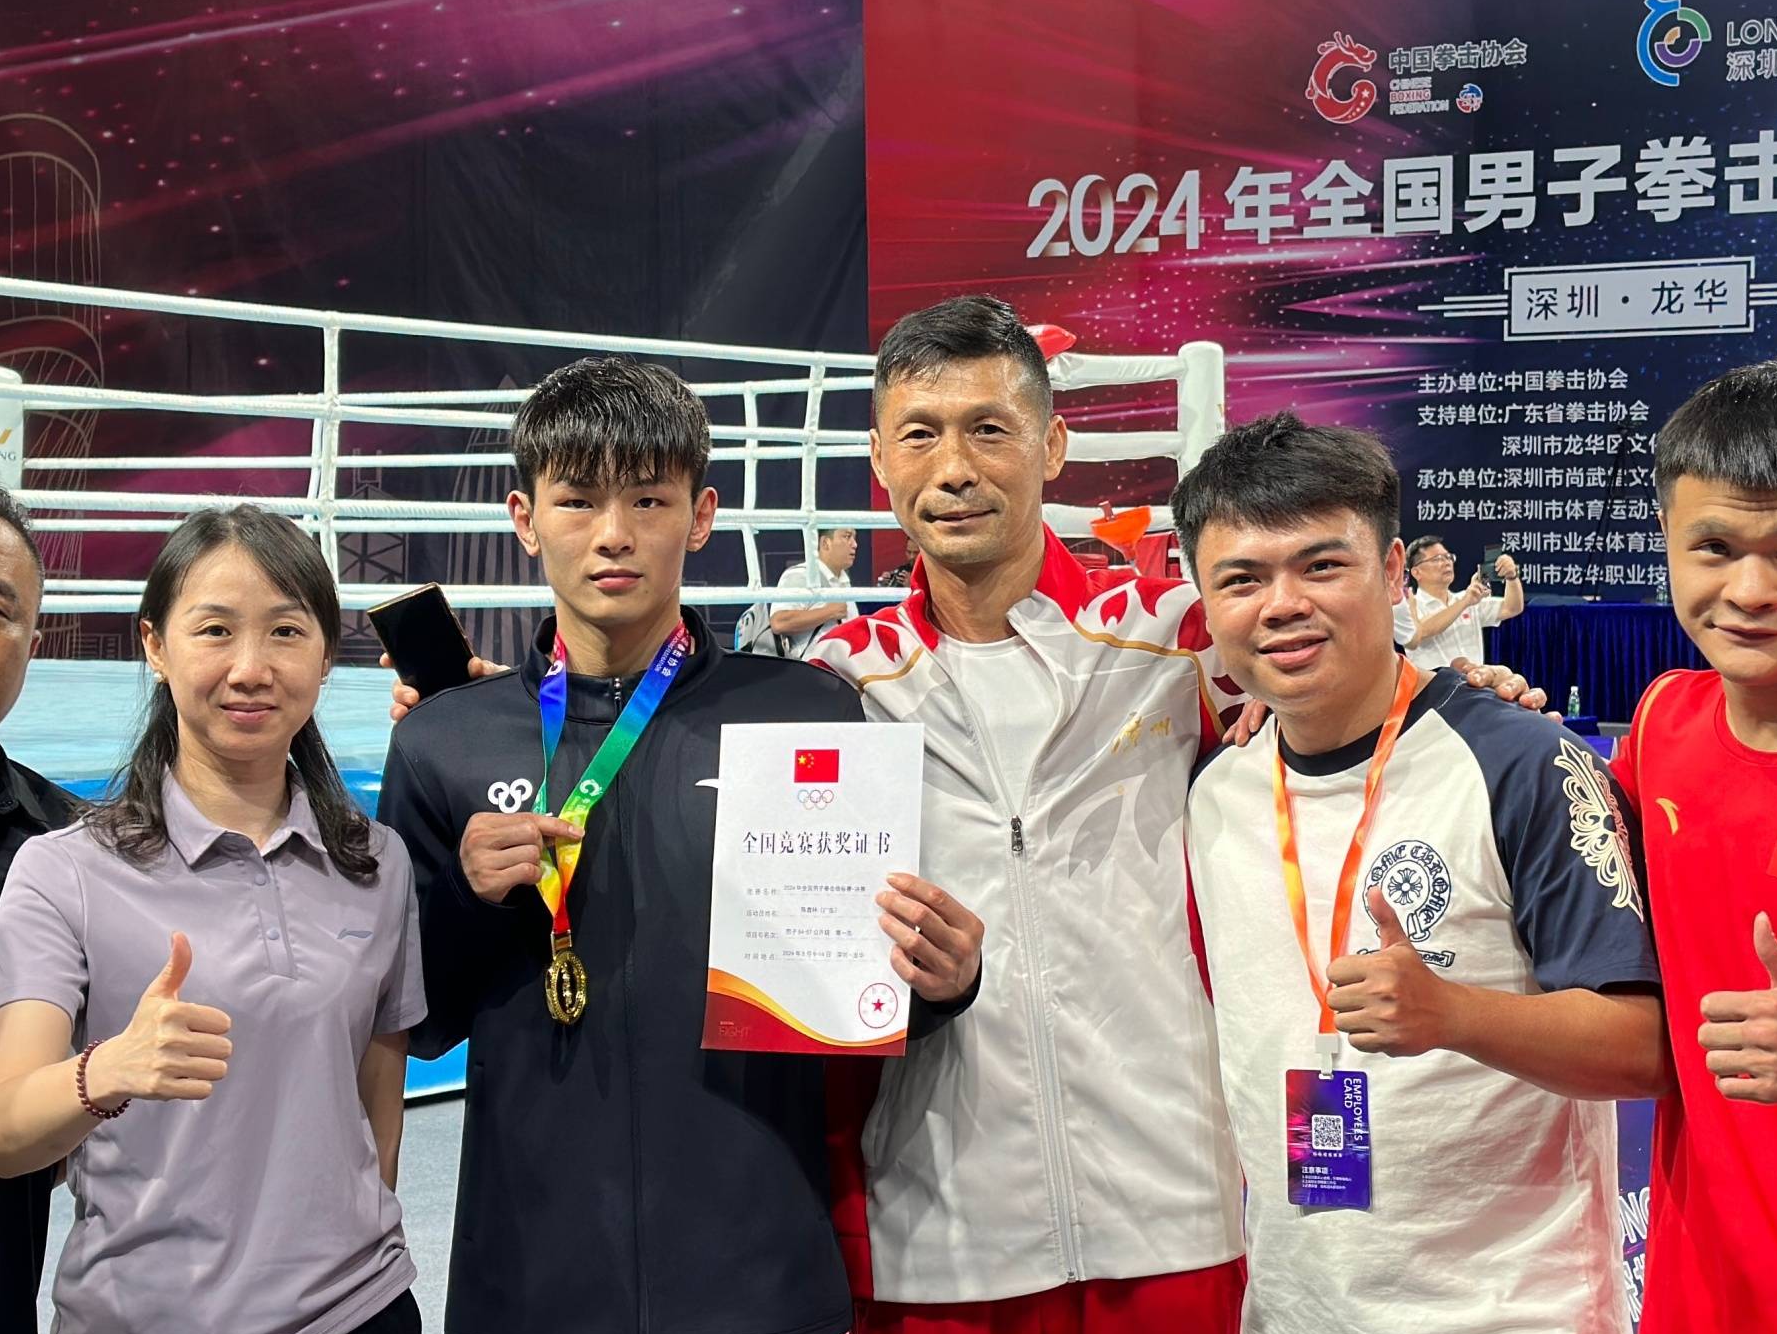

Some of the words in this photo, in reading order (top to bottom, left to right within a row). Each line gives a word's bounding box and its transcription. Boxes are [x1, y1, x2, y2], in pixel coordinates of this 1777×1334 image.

[1388, 38, 1528, 74] 中国拳击协会
[1389, 76, 1433, 90] CHINESE
[1389, 88, 1431, 102] BOXING
[1389, 99, 1449, 115] FEDERATION
[1417, 367, 1629, 394] 主办单位:中国拳击协会
[1417, 400, 1650, 426] 支持单位:广东省拳击协会
[1516, 563, 1668, 586] 圳市龙华职业技
[741, 829, 893, 856] 全国竞赛获奖证书
[1343, 1077, 1353, 1108] CARD
[1353, 1078, 1363, 1141] EMPLOYEES
